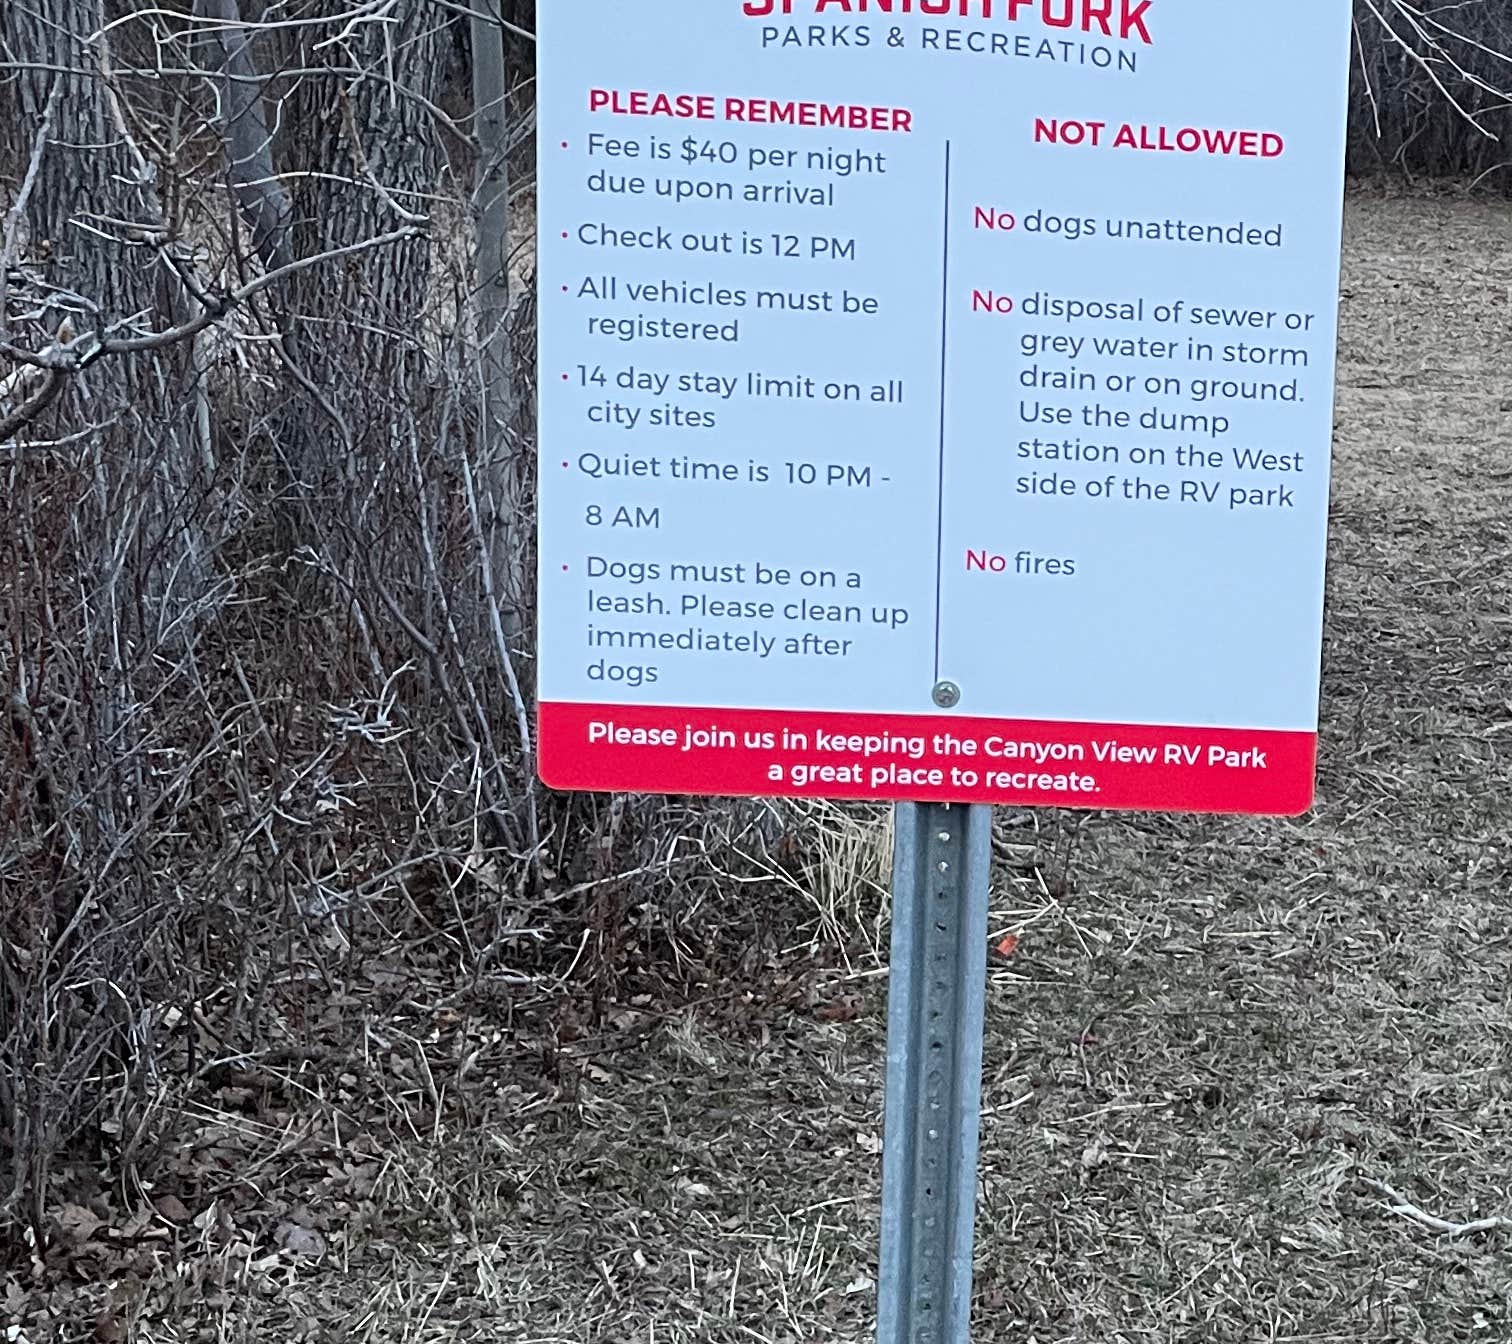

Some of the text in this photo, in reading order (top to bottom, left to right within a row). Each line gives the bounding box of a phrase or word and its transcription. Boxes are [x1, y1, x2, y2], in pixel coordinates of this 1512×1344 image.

[763, 25, 1137, 72] PARKS & RECREATION
[591, 90, 911, 132] PLEASE REMEMBER
[589, 133, 886, 176] Fee is $40 per night
[1035, 119, 1283, 157] NOT ALLOWED
[588, 169, 832, 206] due upon arrival
[578, 223, 854, 260] Check out is 12 PM
[975, 207, 1281, 246] No dogs unattended
[577, 276, 878, 313] All vehicles must be
[973, 290, 1314, 330] No disposal of sewer or
[589, 314, 738, 341] registered
[1021, 335, 1307, 366] grey water in storm
[577, 365, 902, 402] 14 day stay limit on all
[1020, 364, 1303, 402] drain or on ground.
[588, 400, 715, 429] city sites
[1020, 401, 1228, 438] Use the dump
[579, 453, 660, 478] Quiet
[670, 456, 738, 480] time
[749, 460, 768, 481] is
[785, 463, 816, 484] 10
[828, 465, 870, 487] PM
[1018, 438, 1303, 472] station on the West
[1017, 472, 1293, 509] side of the RV park
[586, 505, 659, 528] 8 AM
[588, 556, 860, 588] Dogs must be on a
[967, 550, 1074, 575] No fires
[589, 590, 908, 629] leash. Please clean up
[589, 624, 852, 658] immediately after
[587, 659, 657, 687] dogs
[589, 722, 1266, 768] Please join us in keeping the Canyon View RV Park
[768, 763, 1100, 791] a great place to recreate.
